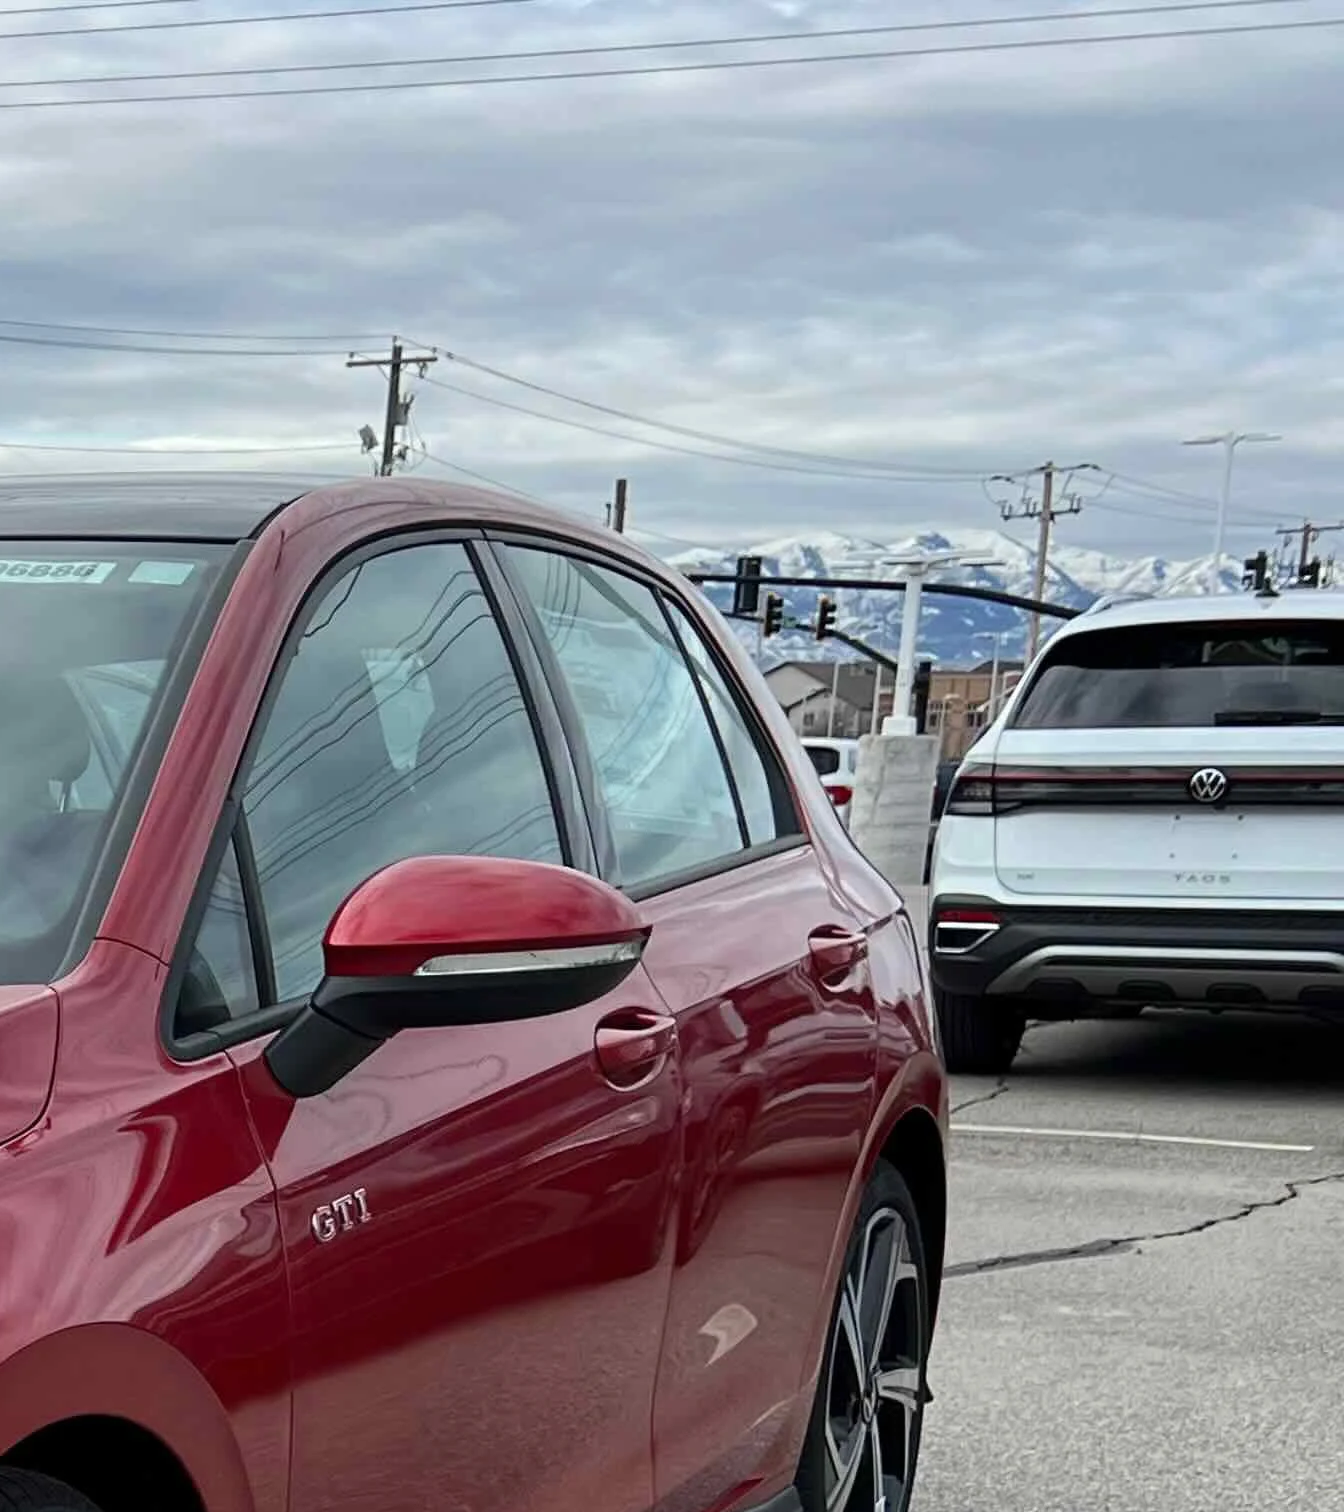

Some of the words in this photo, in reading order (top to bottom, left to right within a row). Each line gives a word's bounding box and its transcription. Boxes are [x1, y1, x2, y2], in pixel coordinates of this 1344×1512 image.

[1191, 768, 1226, 801] VW
[1173, 871, 1231, 884] TAOS
[311, 1187, 372, 1242] GTI
